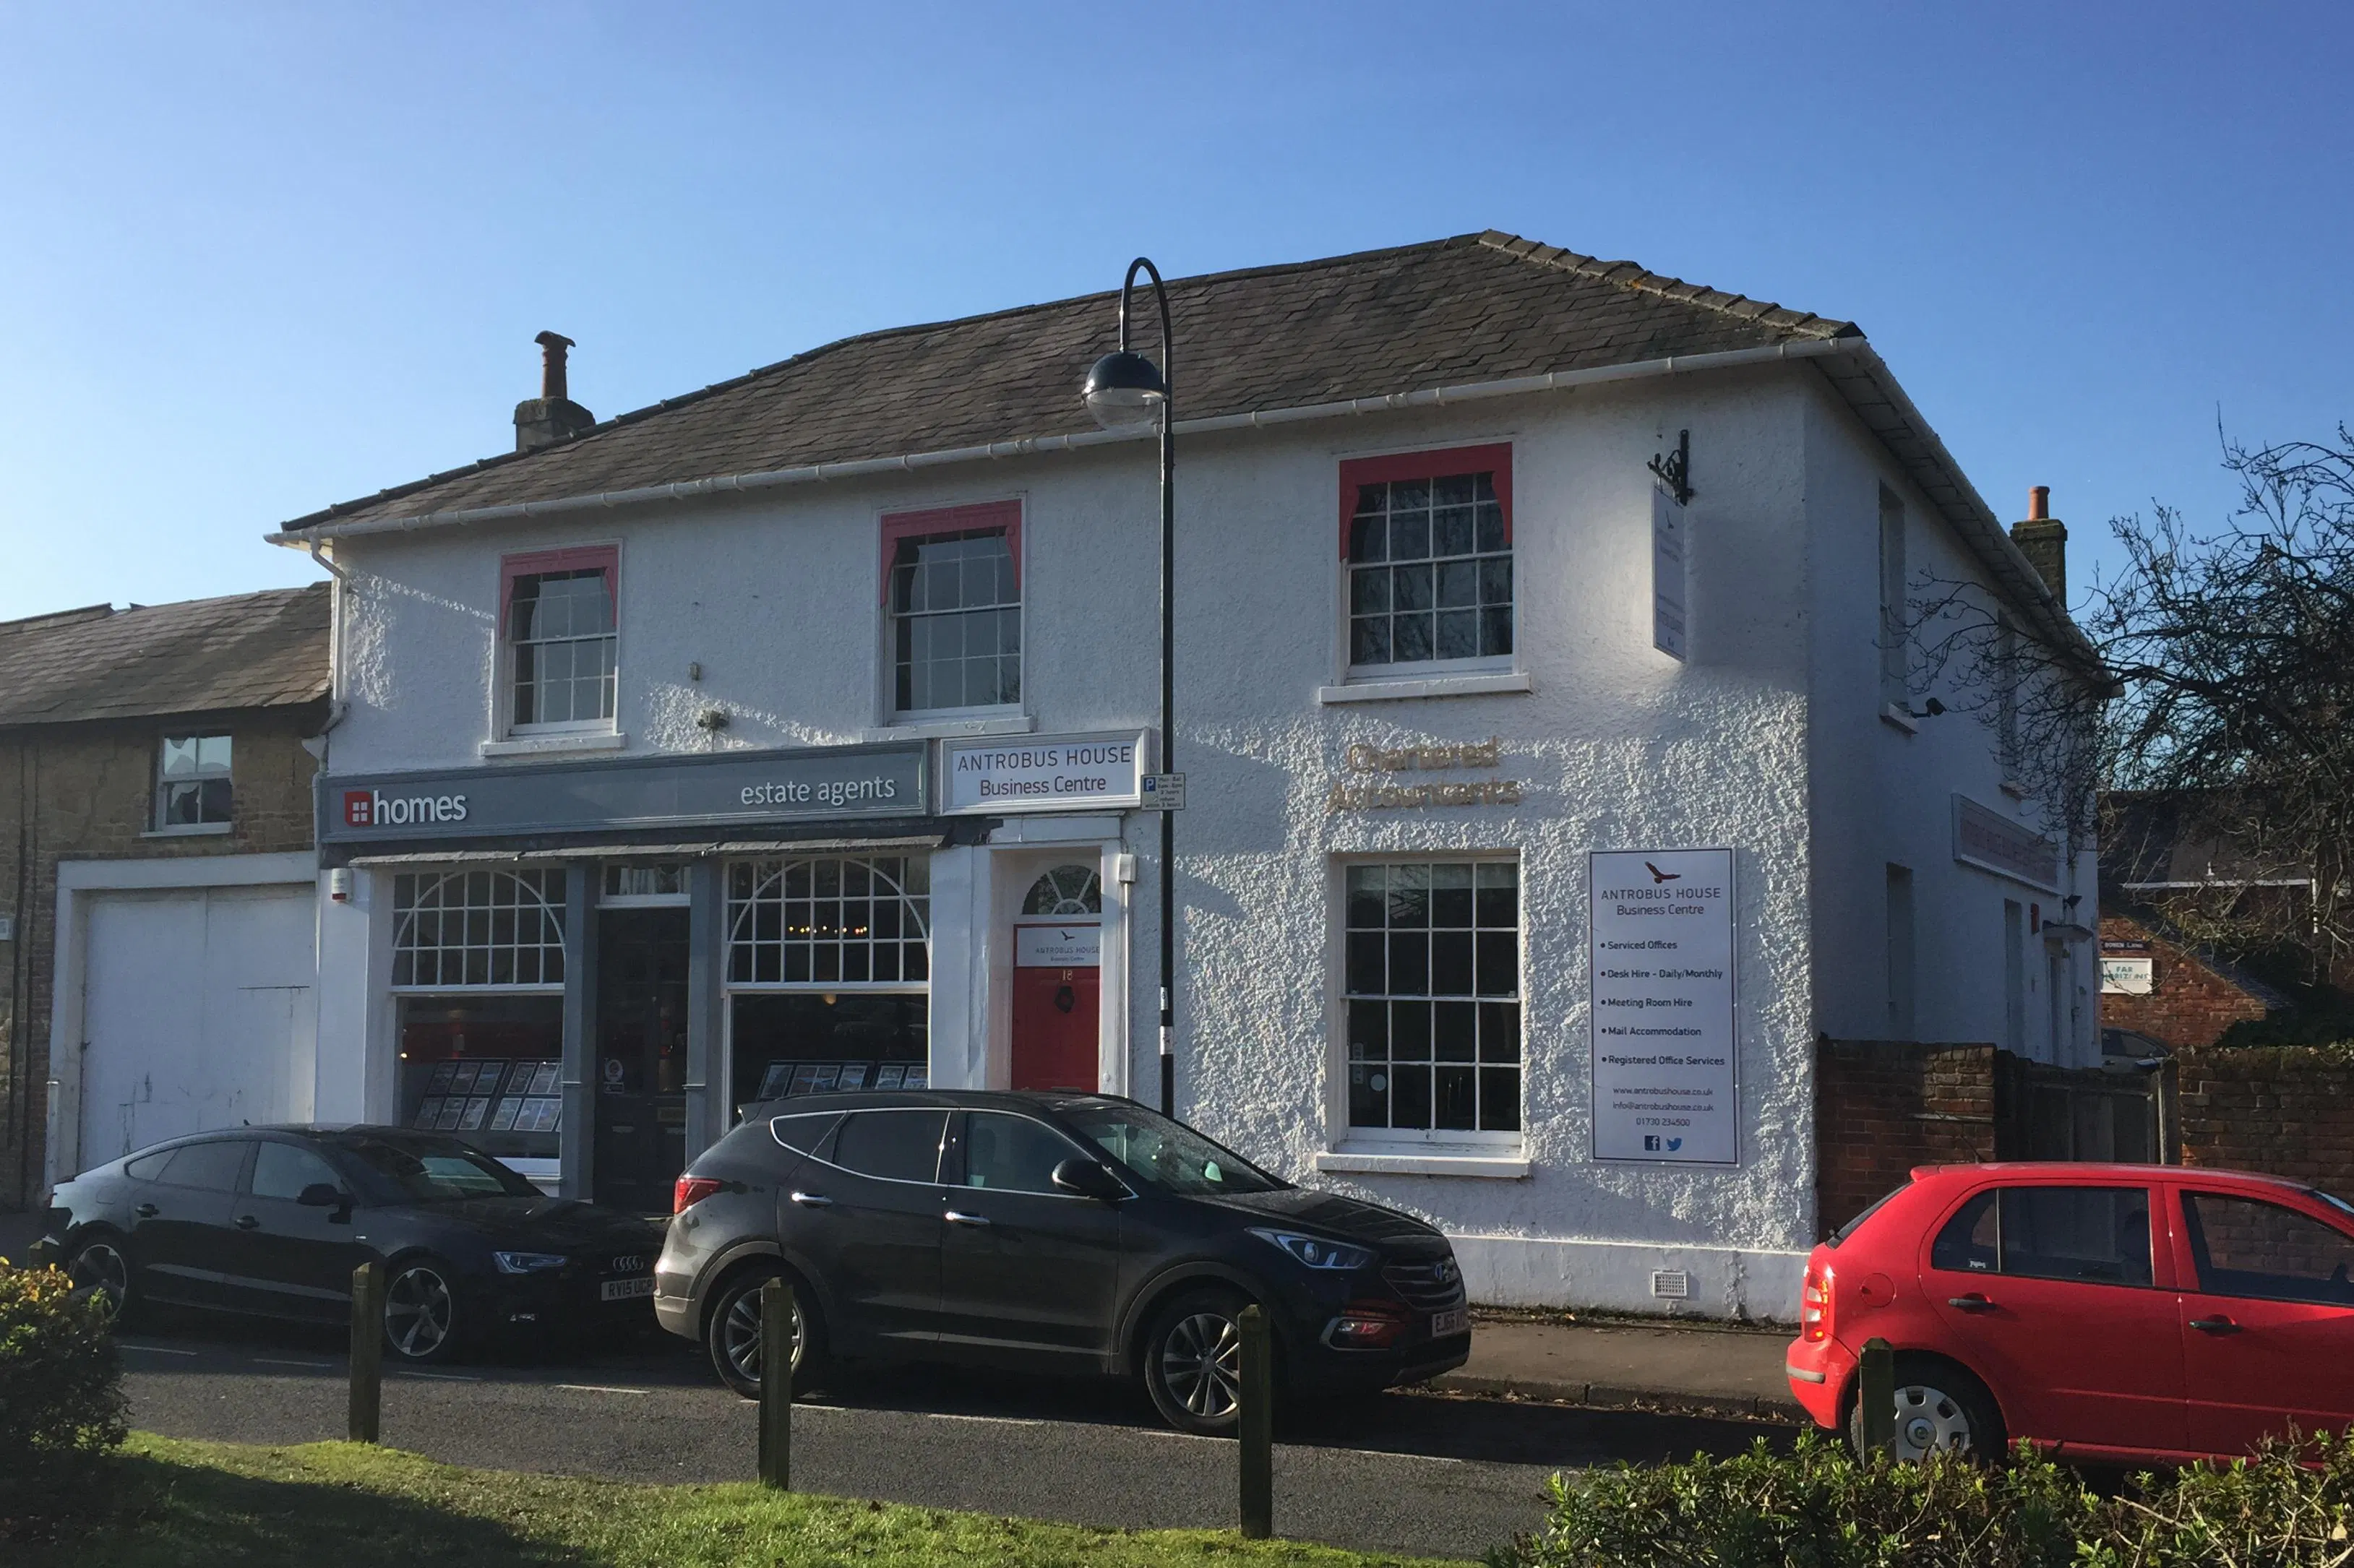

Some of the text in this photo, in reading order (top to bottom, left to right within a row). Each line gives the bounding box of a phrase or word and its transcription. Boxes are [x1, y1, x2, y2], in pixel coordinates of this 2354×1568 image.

[957, 746, 1131, 772] ANTROBUS HOUSE
[741, 775, 895, 806] estate agents
[980, 775, 1107, 796] Business Centre
[373, 790, 467, 824] homes
[1601, 887, 1721, 900] ANTROBUS HOUSE
[1617, 904, 1704, 916] Business Centre
[1607, 940, 1678, 949] Serviced Offices
[1607, 969, 1629, 978] Desk
[1631, 969, 1650, 978] Hire
[1659, 969, 1723, 980] Daily/Monthly
[1607, 999, 1693, 1009] Meeting Room Hire
[1608, 1027, 1701, 1036] Mail Accommodation
[1608, 1055, 1725, 1066] Registered Office Services
[1612, 1087, 1713, 1096] www.antrobushouse.co.uk
[1612, 1101, 1714, 1111] info@antrobushouse.co.uk
